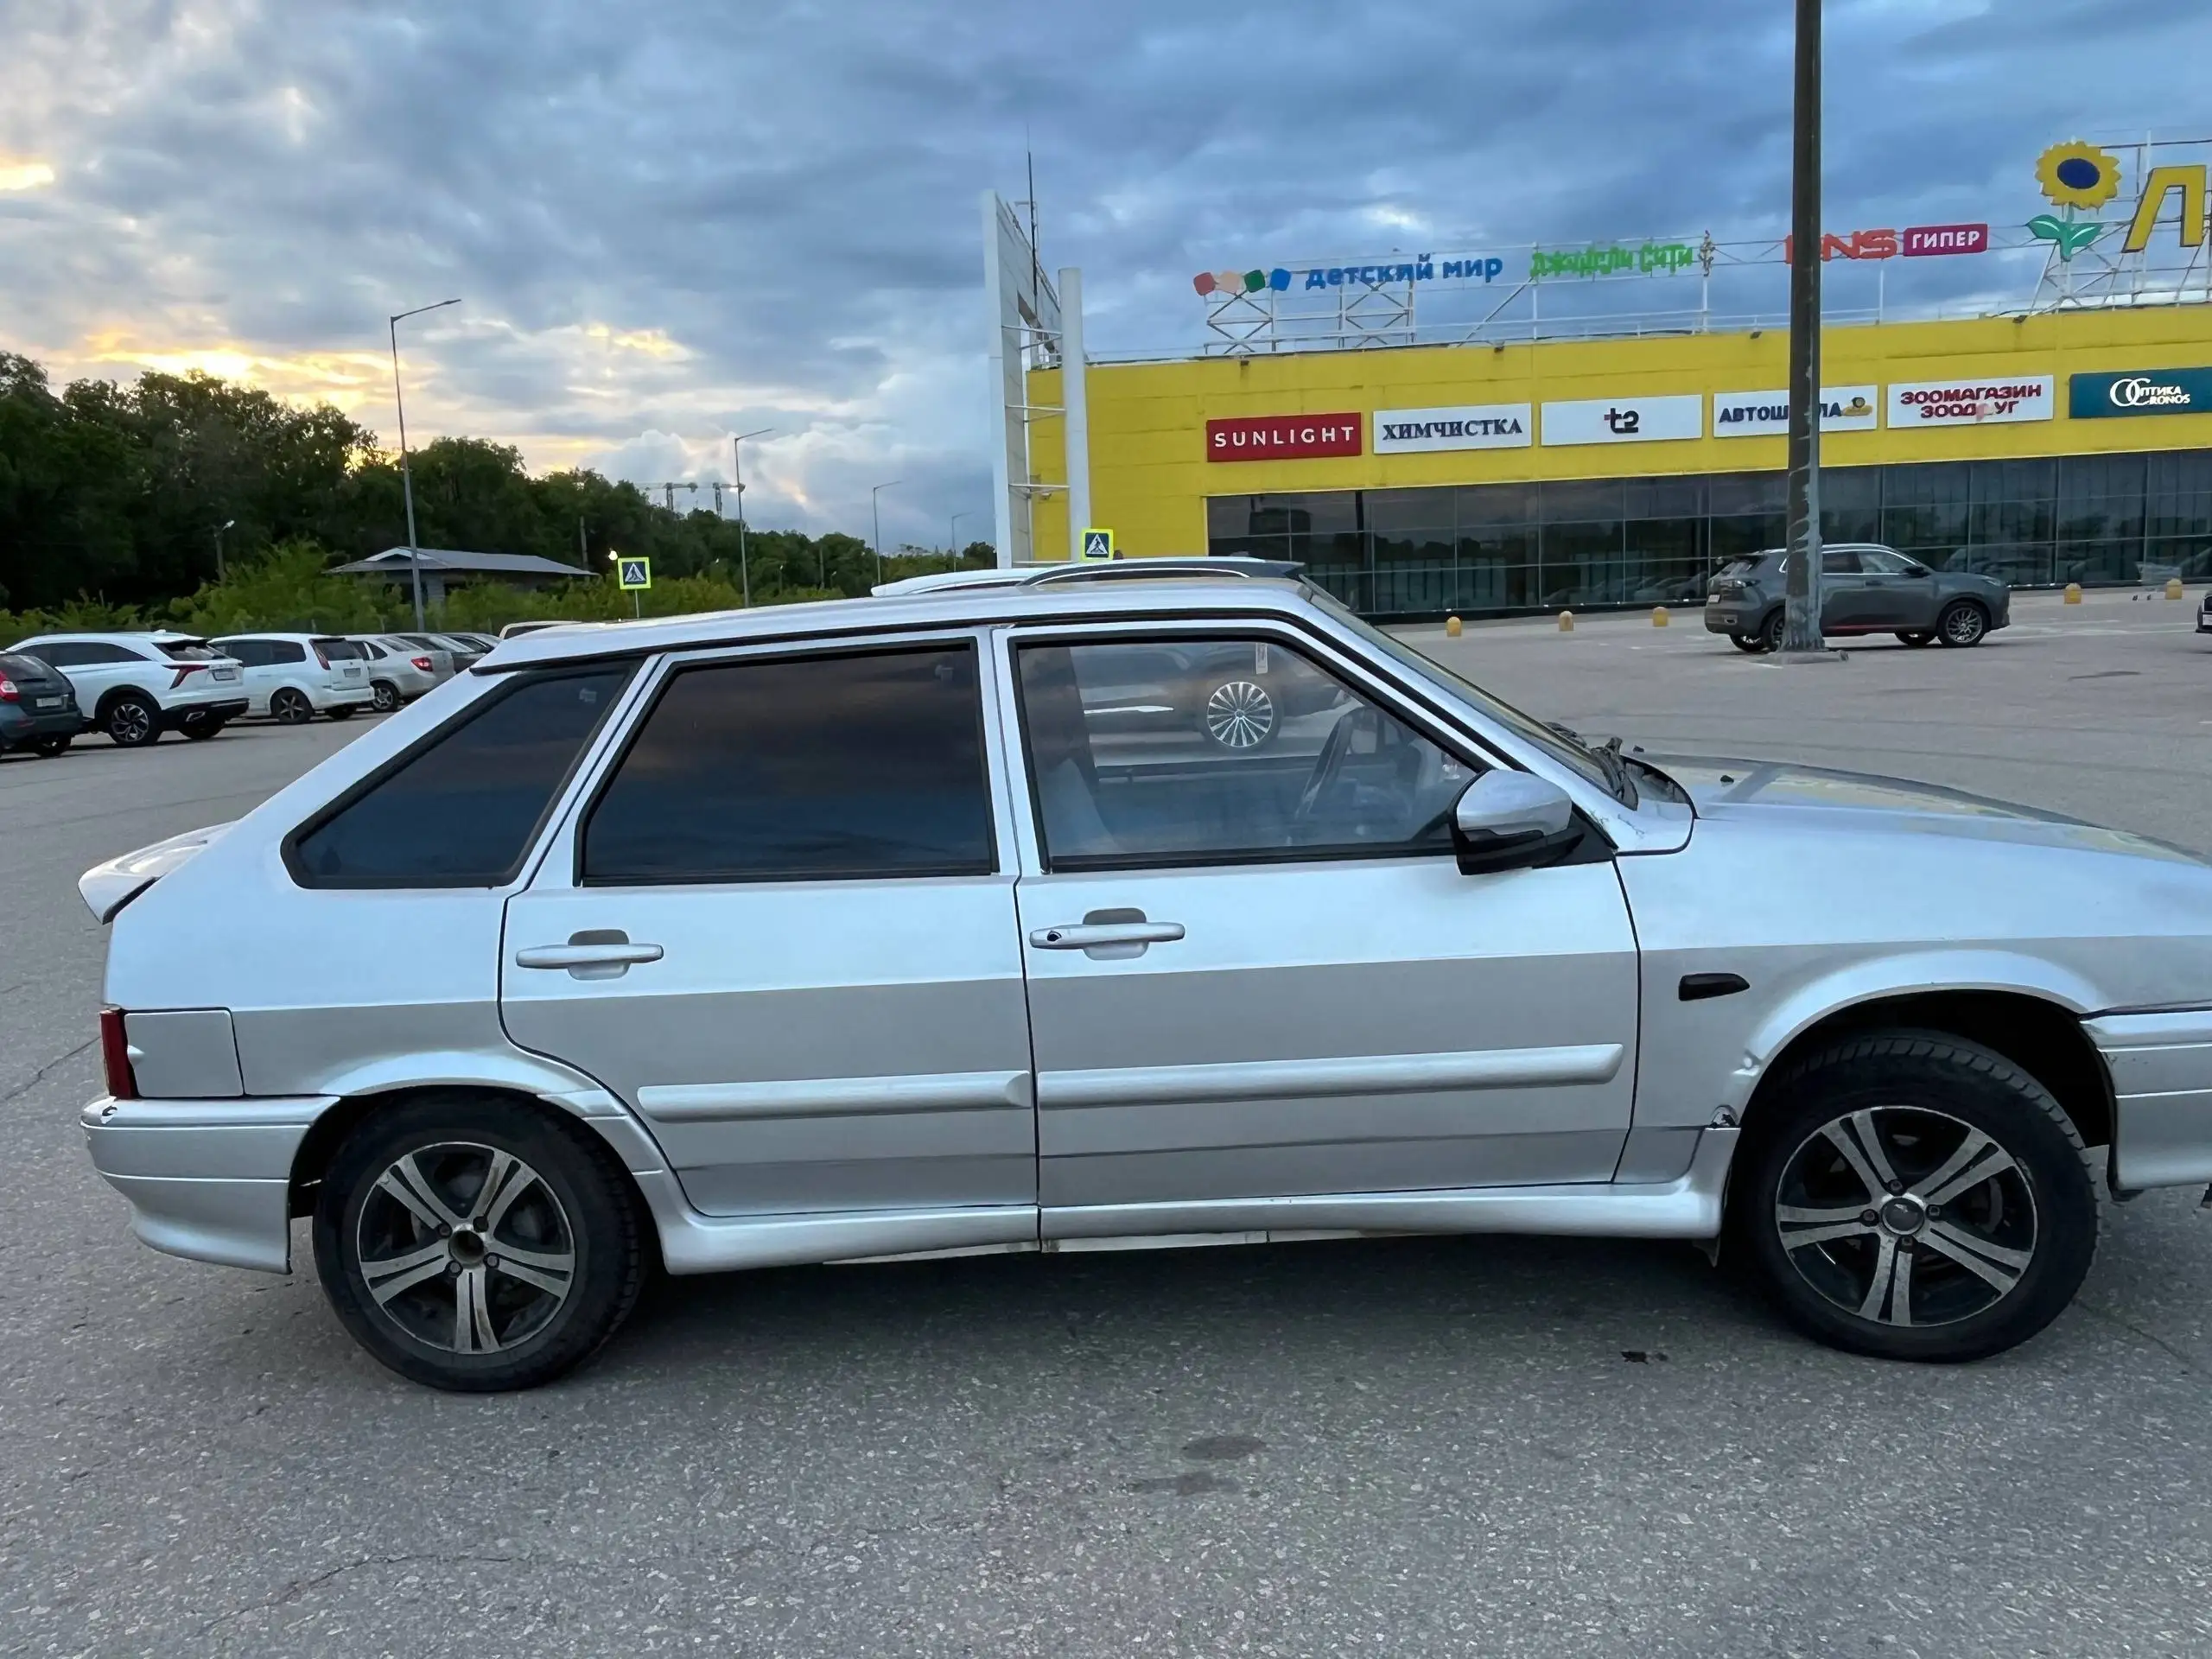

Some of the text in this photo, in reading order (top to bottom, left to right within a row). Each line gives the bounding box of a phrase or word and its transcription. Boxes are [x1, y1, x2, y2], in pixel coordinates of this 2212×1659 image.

[1785, 229, 1897, 264] NS
[1911, 230, 1980, 250] ГИПЕР
[1306, 253, 1503, 289] детский мир
[1900, 384, 2042, 405] ЗООМАГАЗИН
[1604, 408, 1639, 434] t2
[1718, 401, 1842, 423] АВТОШЛА
[1214, 426, 1354, 448] SUNLIGHT
[1382, 417, 1522, 442] ХИМЧИСТКА
